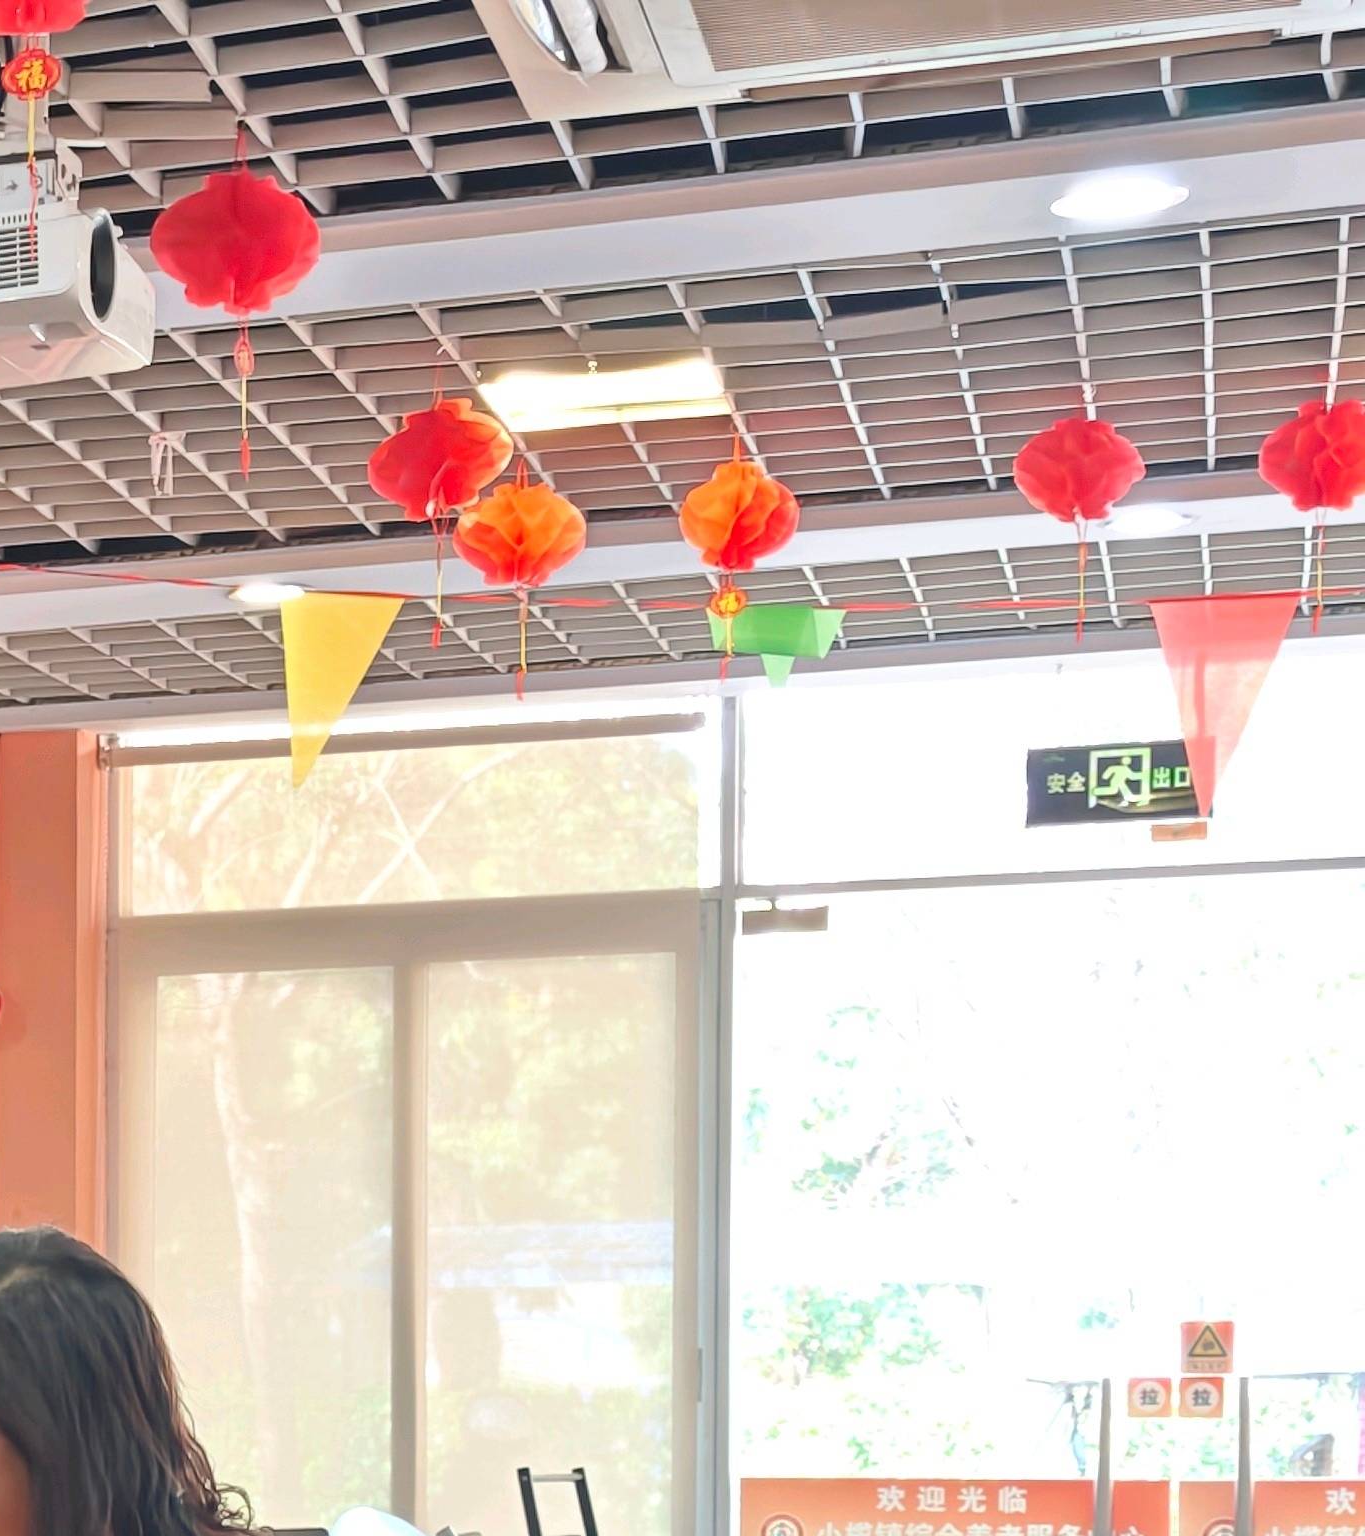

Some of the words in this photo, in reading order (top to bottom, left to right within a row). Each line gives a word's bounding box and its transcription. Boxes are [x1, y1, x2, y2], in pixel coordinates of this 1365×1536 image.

[15, 58, 47, 92] 福
[1047, 772, 1086, 793] 安全
[1153, 766, 1191, 788] 出口
[1139, 1388, 1159, 1406] 拉
[1192, 1388, 1212, 1407] 拉
[876, 1485, 1029, 1514] 欢迎光临
[1324, 1486, 1357, 1516] 欢
